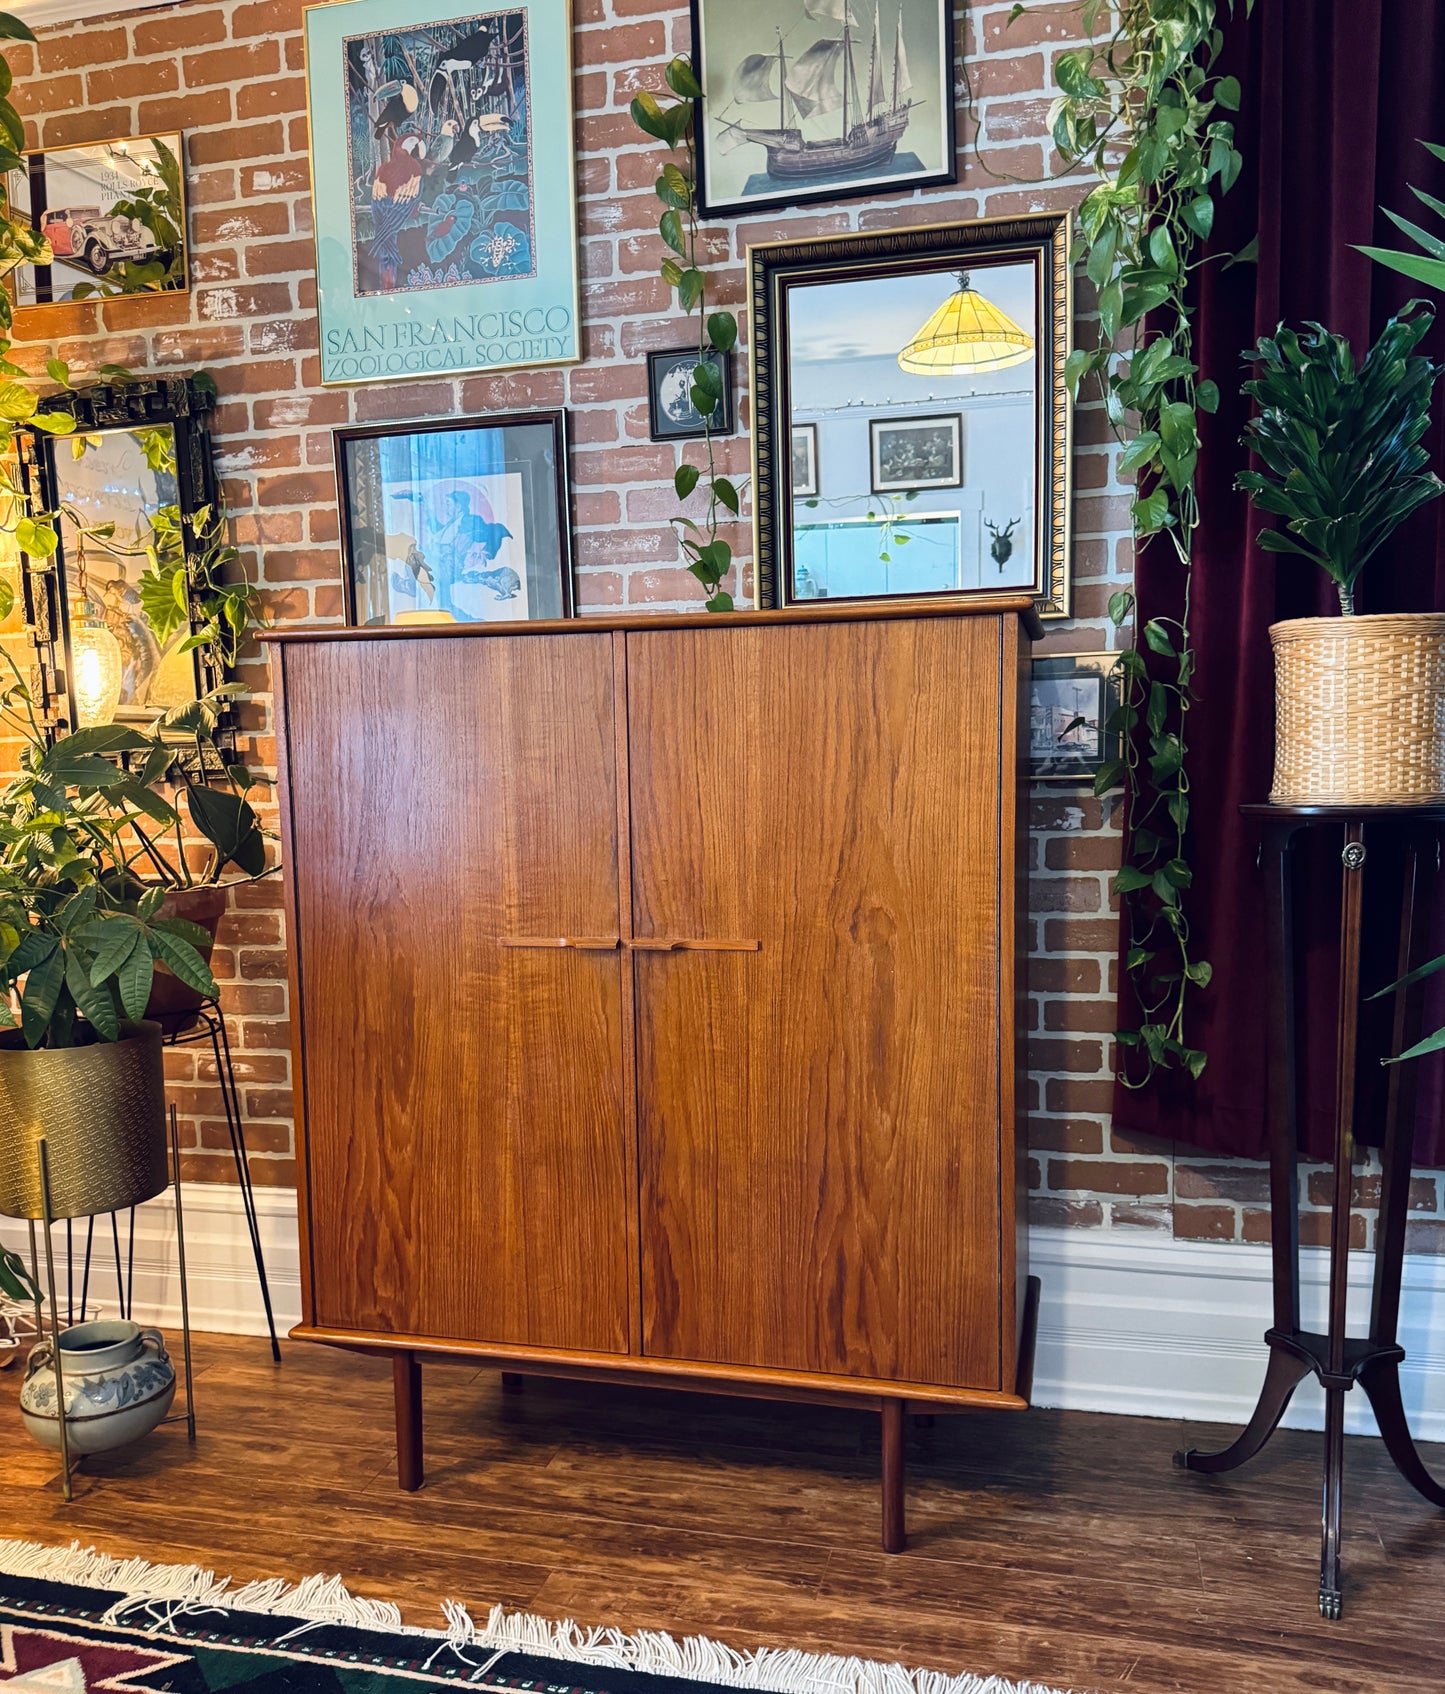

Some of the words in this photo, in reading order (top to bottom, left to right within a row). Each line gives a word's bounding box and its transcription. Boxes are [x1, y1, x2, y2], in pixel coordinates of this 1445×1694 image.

[101, 171, 118, 181] 1934
[327, 325, 386, 355] SAN
[393, 305, 570, 349] FRANCISCO
[327, 346, 471, 378] ZOOLOGICAL
[475, 336, 570, 364] SOCIETY
